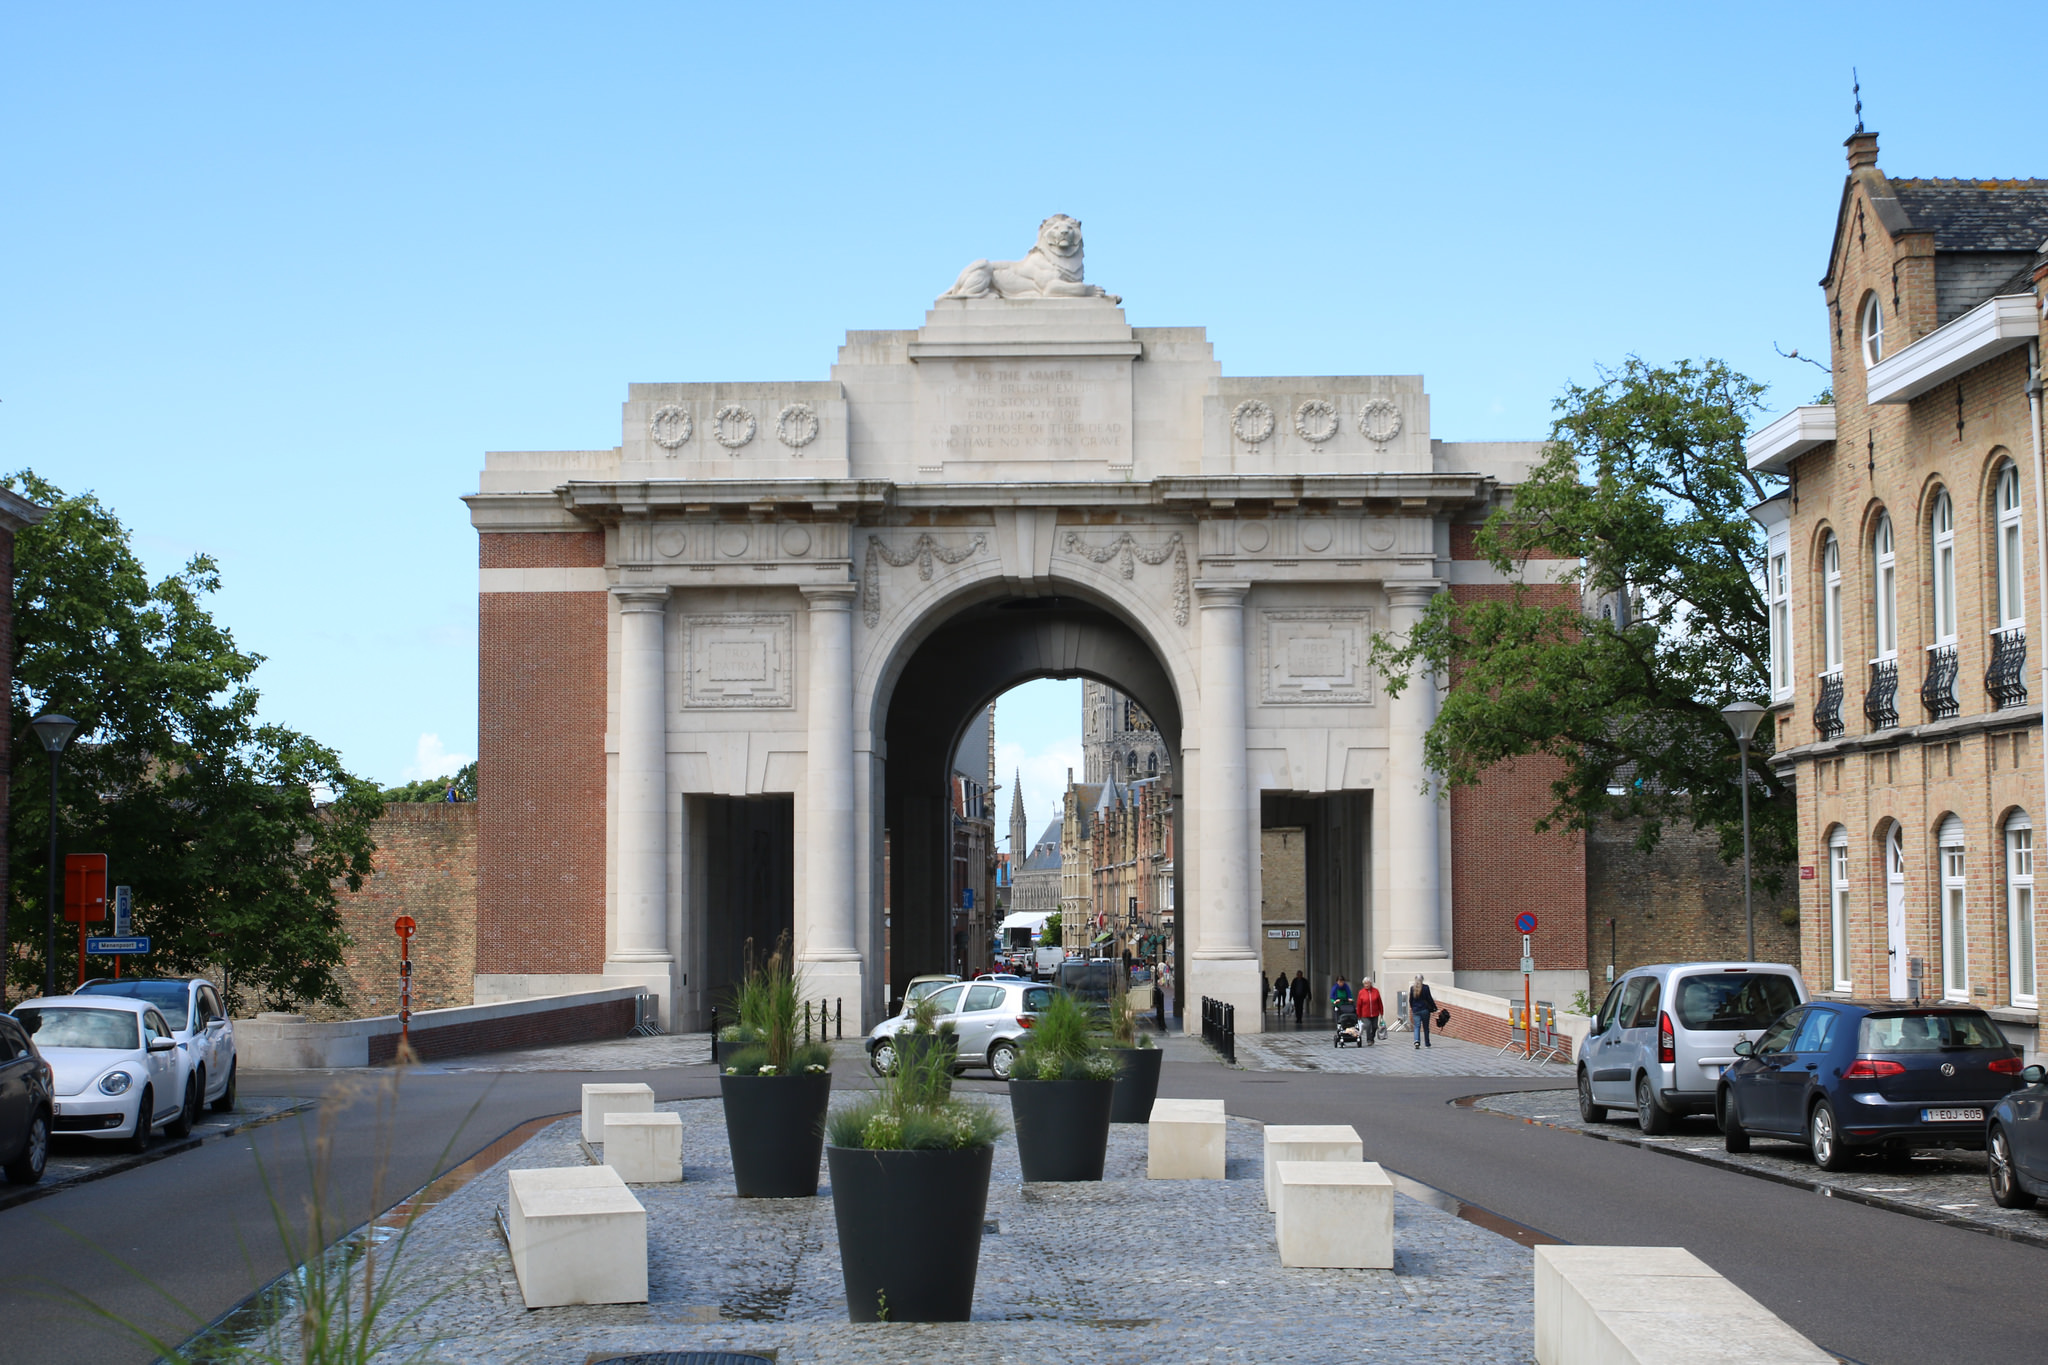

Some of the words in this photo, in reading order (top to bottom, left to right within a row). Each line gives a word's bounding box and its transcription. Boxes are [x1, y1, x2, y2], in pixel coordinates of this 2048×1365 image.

[977, 371, 992, 382] TO
[998, 371, 1020, 381] THE
[1028, 370, 1073, 381] ARMIES
[1001, 383, 1049, 393] BRITISH
[1047, 397, 1081, 407] HERE
[966, 424, 980, 434] TO
[987, 423, 1024, 434] THOSE
[1050, 423, 1085, 433] THEIR
[963, 438, 993, 448] HAVE
[1000, 437, 1020, 448] NO
[1080, 436, 1121, 447] GRAVE
